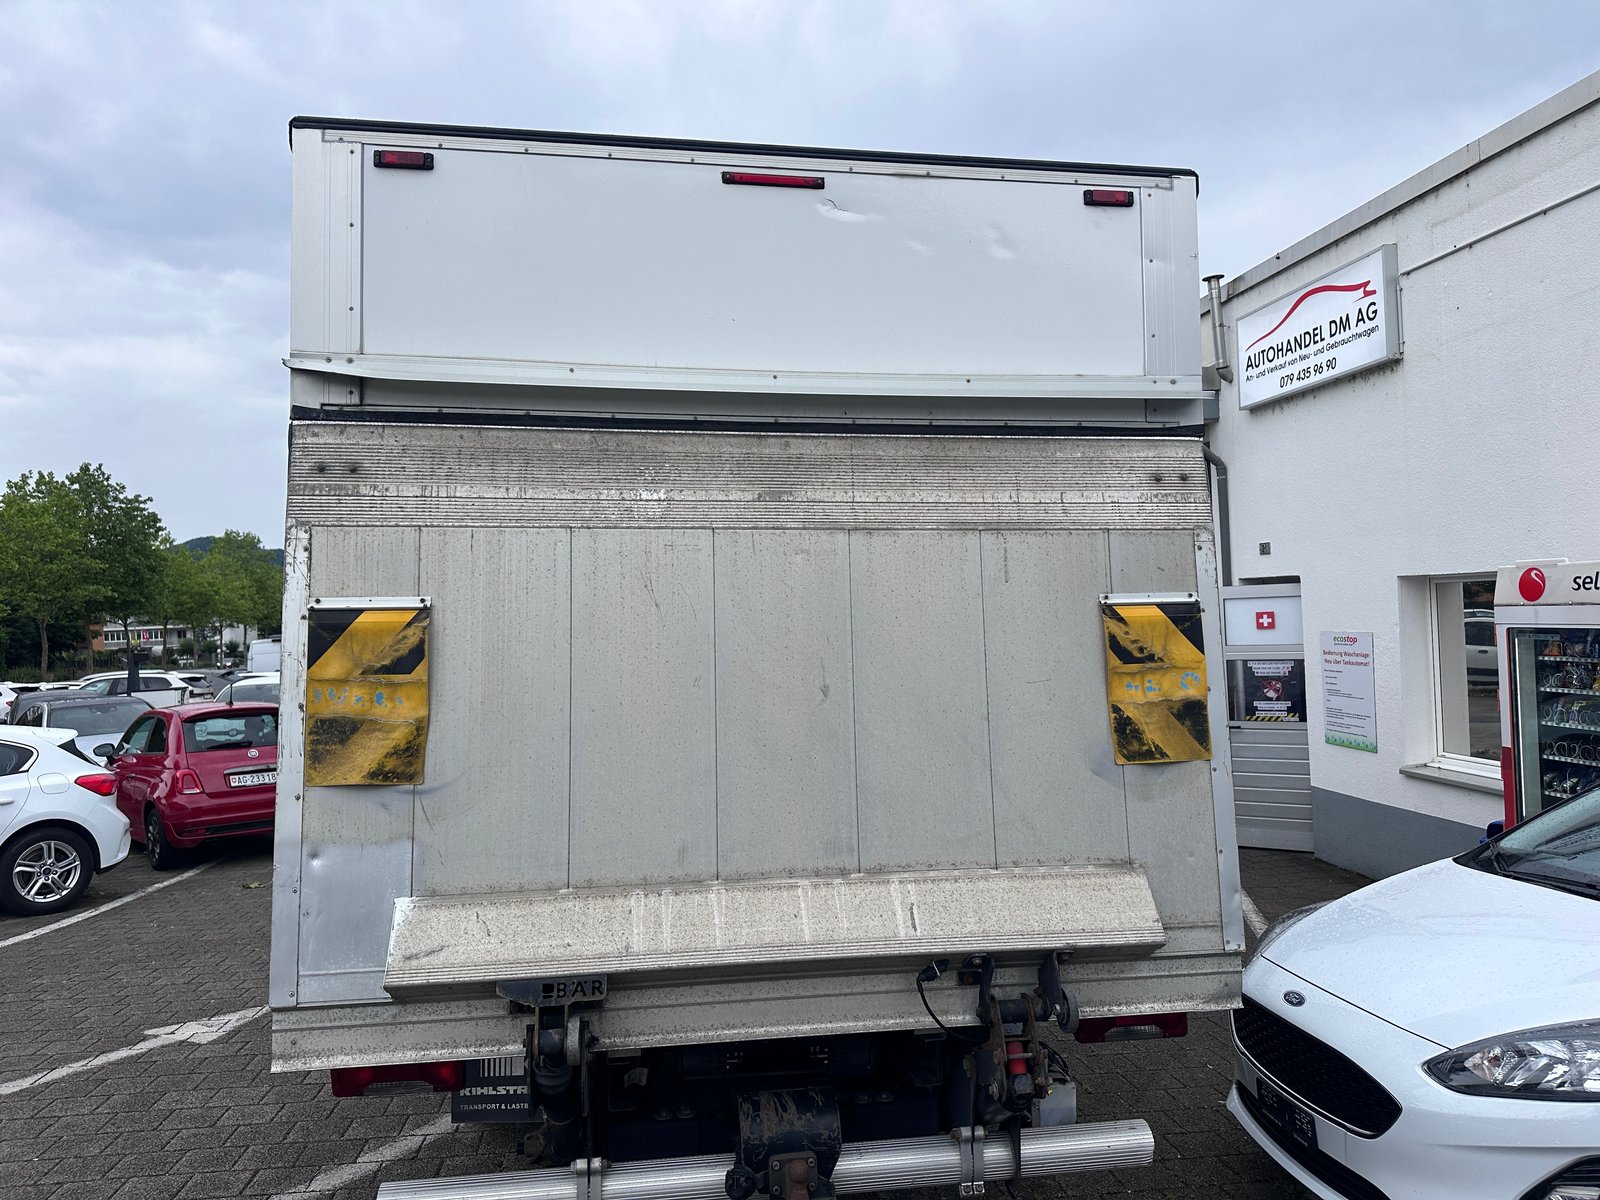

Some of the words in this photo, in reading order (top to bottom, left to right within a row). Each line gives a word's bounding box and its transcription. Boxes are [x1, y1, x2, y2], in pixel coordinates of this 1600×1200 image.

[1245, 324, 1326, 372] AUTOHANDEL
[1328, 312, 1351, 338] DM
[1355, 301, 1378, 328] AG
[1245, 373, 1256, 383] An-
[1255, 368, 1266, 379] und
[1266, 361, 1288, 375] Verkauf
[1287, 357, 1298, 368] von
[1298, 351, 1313, 364] Neu-
[1313, 344, 1325, 357] und
[1325, 324, 1380, 353] Gebrauchtwagen
[1279, 373, 1295, 389] 079
[1295, 366, 1312, 382] 435
[1312, 361, 1324, 377] 96
[1325, 356, 1337, 372] 90
[1333, 635, 1358, 645] ecostop
[556, 979, 604, 999] BÄR
[460, 1103, 499, 1111] TRANSPORT
